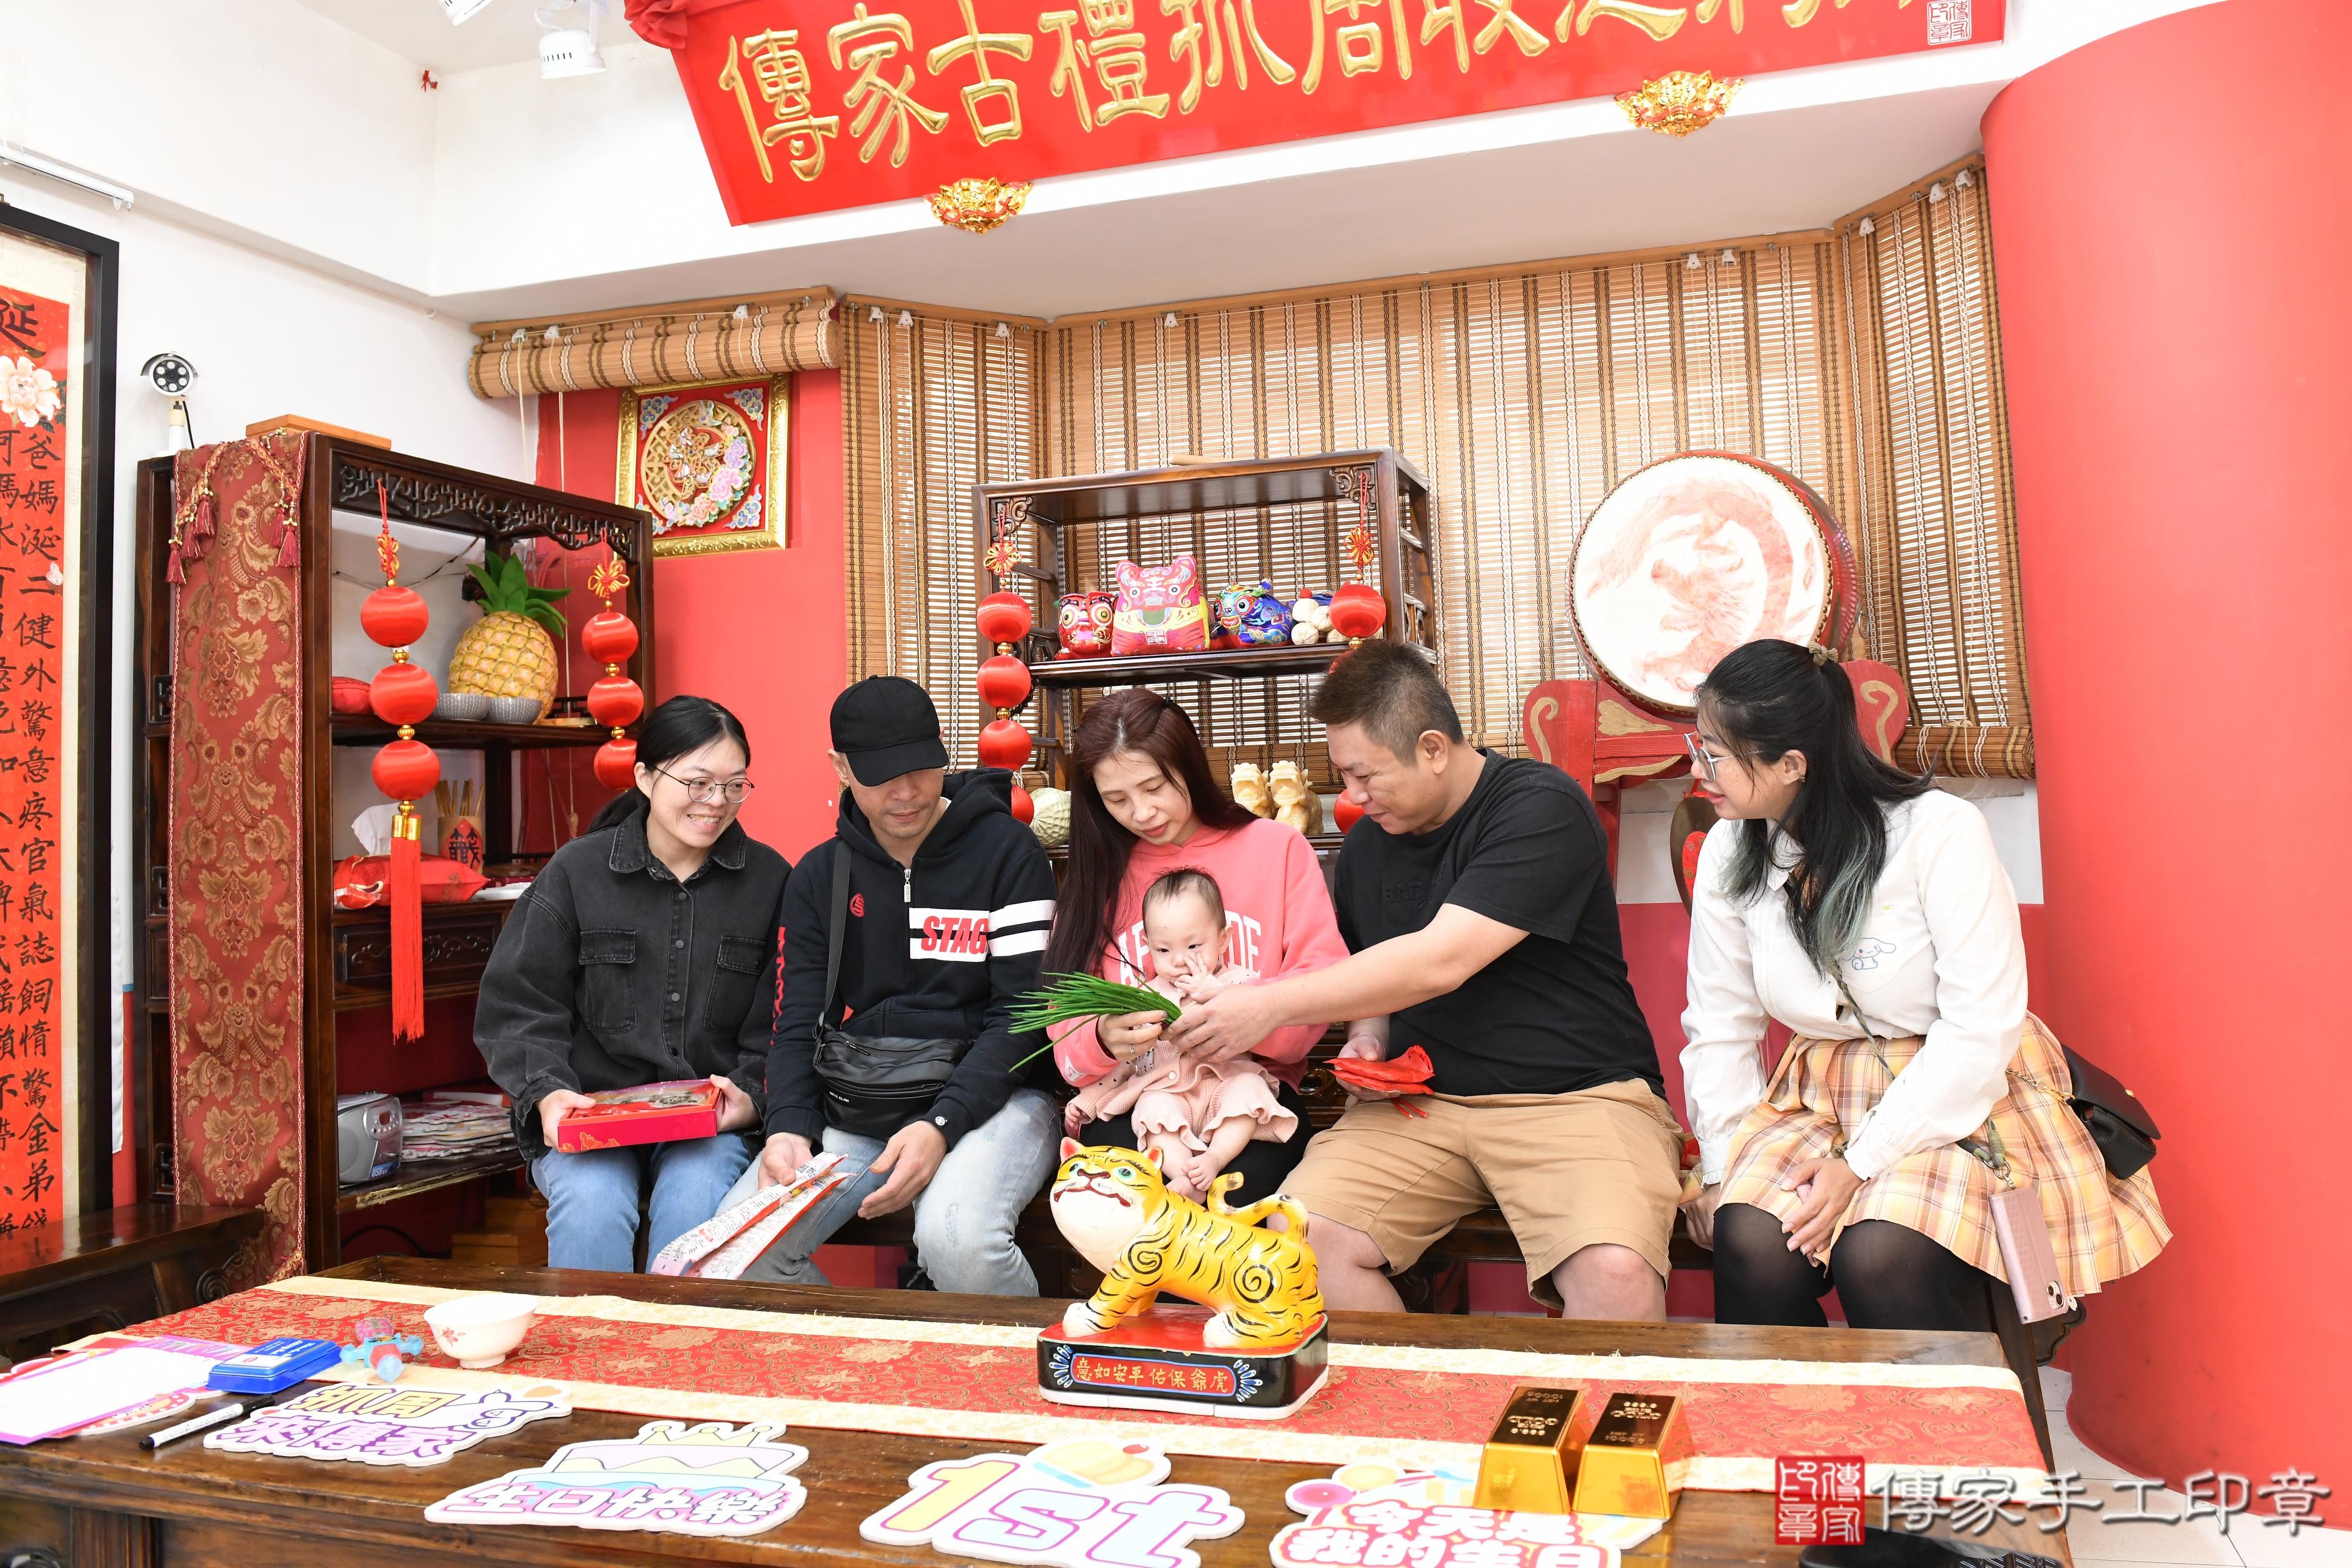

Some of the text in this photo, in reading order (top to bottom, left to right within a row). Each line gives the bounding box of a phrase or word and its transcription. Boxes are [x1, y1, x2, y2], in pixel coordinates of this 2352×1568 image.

[921, 915, 990, 955] STAG
[289, 1385, 465, 1419] 抓周
[445, 1484, 792, 1526] 生日快樂
